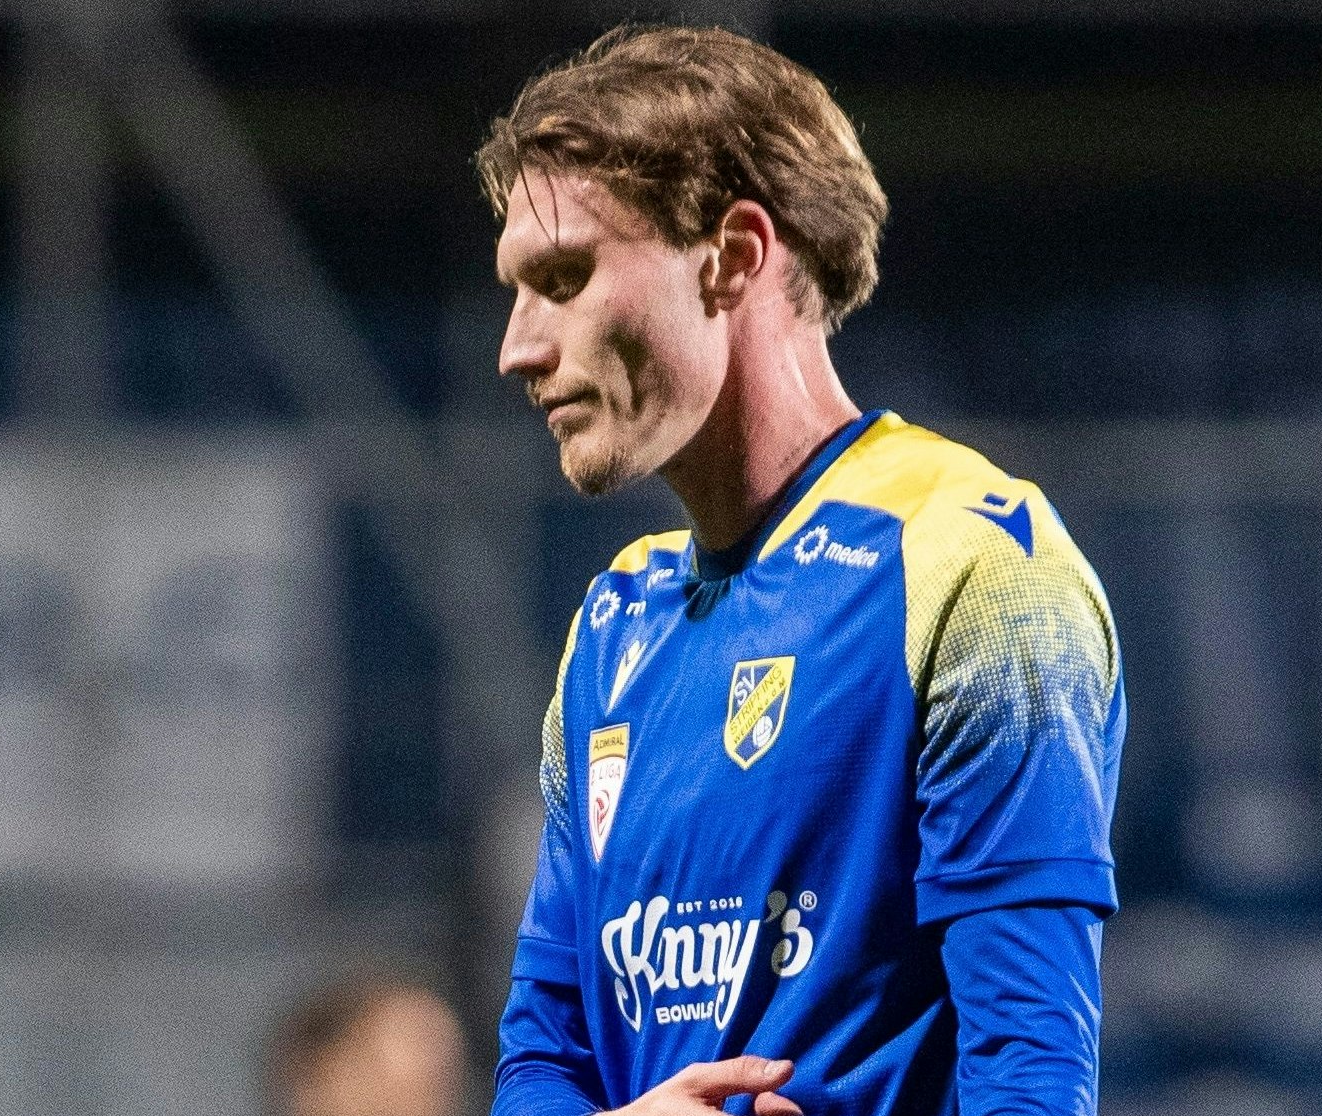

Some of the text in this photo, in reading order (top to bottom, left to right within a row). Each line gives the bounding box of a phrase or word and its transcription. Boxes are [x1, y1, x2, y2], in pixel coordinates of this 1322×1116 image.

[735, 666, 755, 705] SV
[593, 734, 625, 751] ADMIRAL
[676, 901, 702, 915] EST
[655, 1001, 714, 1024] BOWLS
